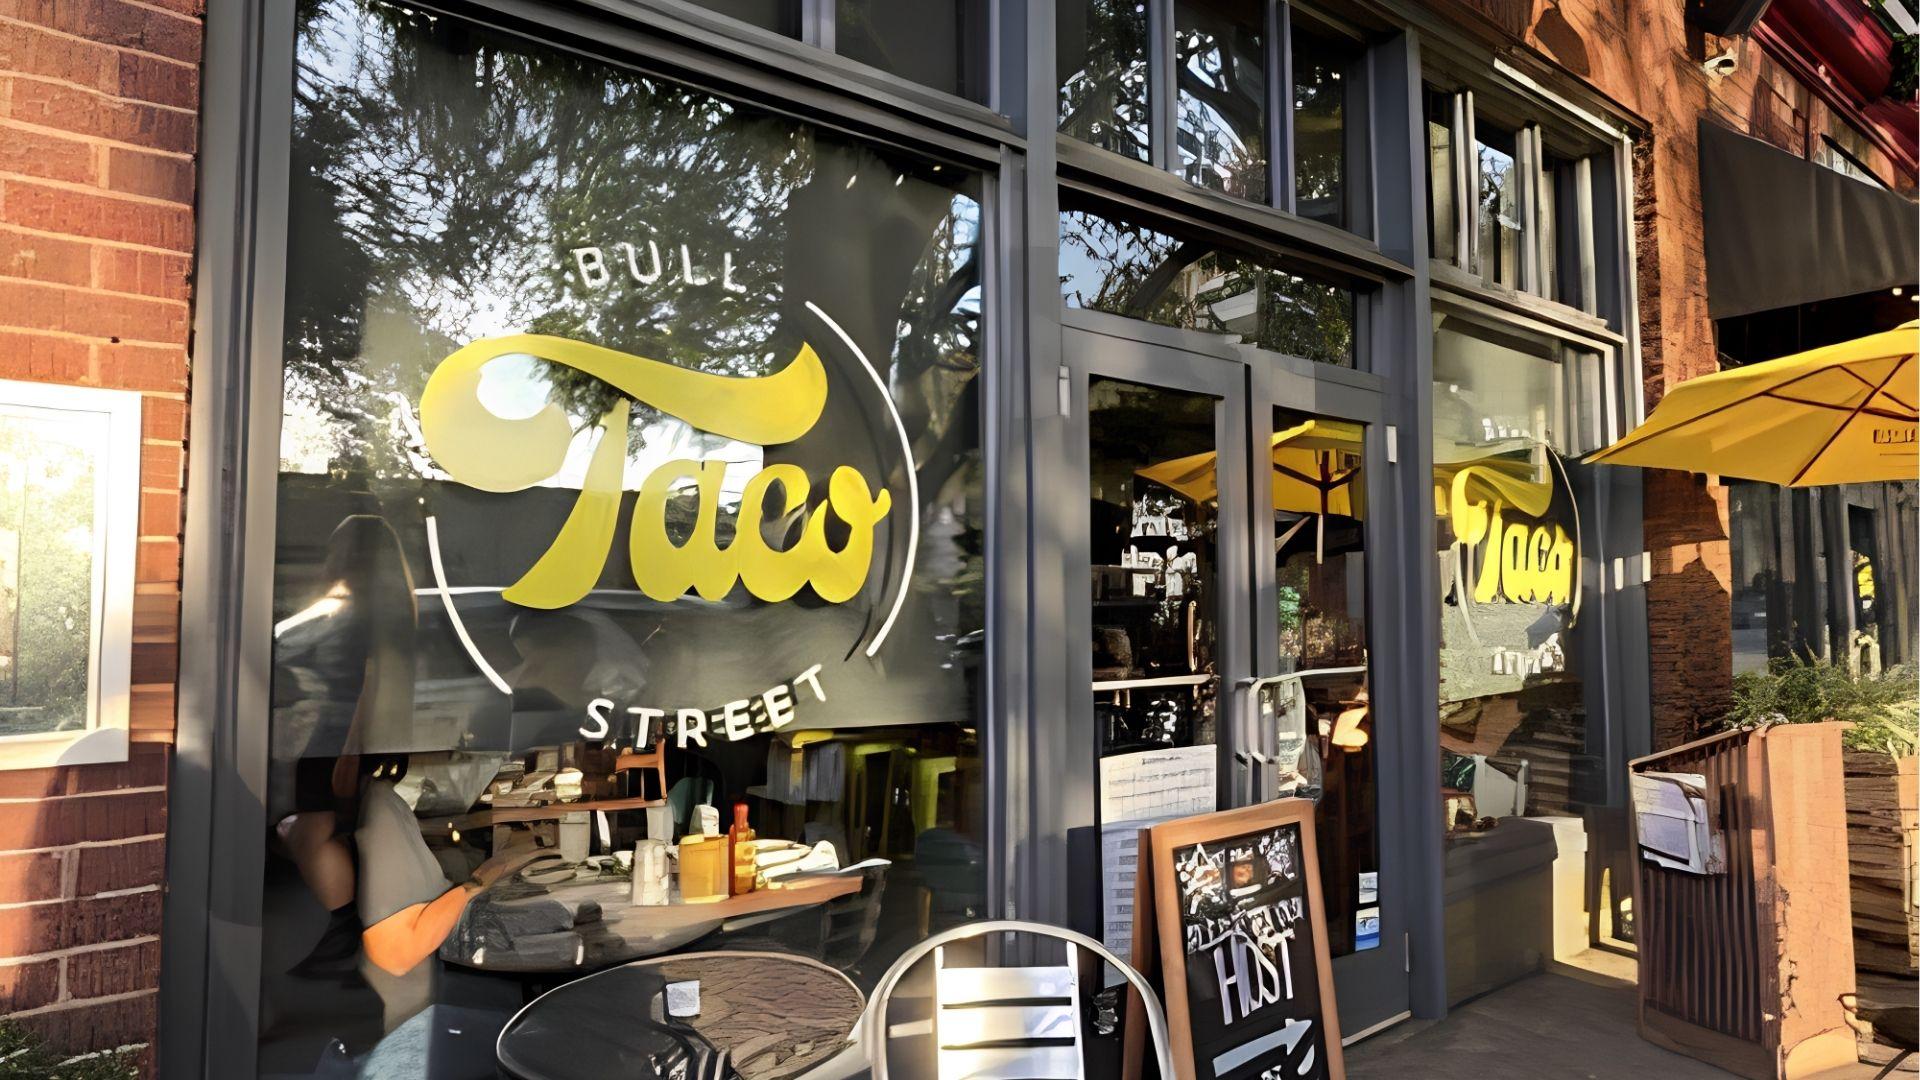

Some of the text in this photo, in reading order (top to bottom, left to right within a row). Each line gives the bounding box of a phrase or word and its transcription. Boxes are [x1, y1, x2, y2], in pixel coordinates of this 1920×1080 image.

[574, 240, 746, 292] BULL
[419, 334, 892, 610] Taco
[1452, 466, 1573, 604] Taco
[579, 664, 827, 748] STREET
